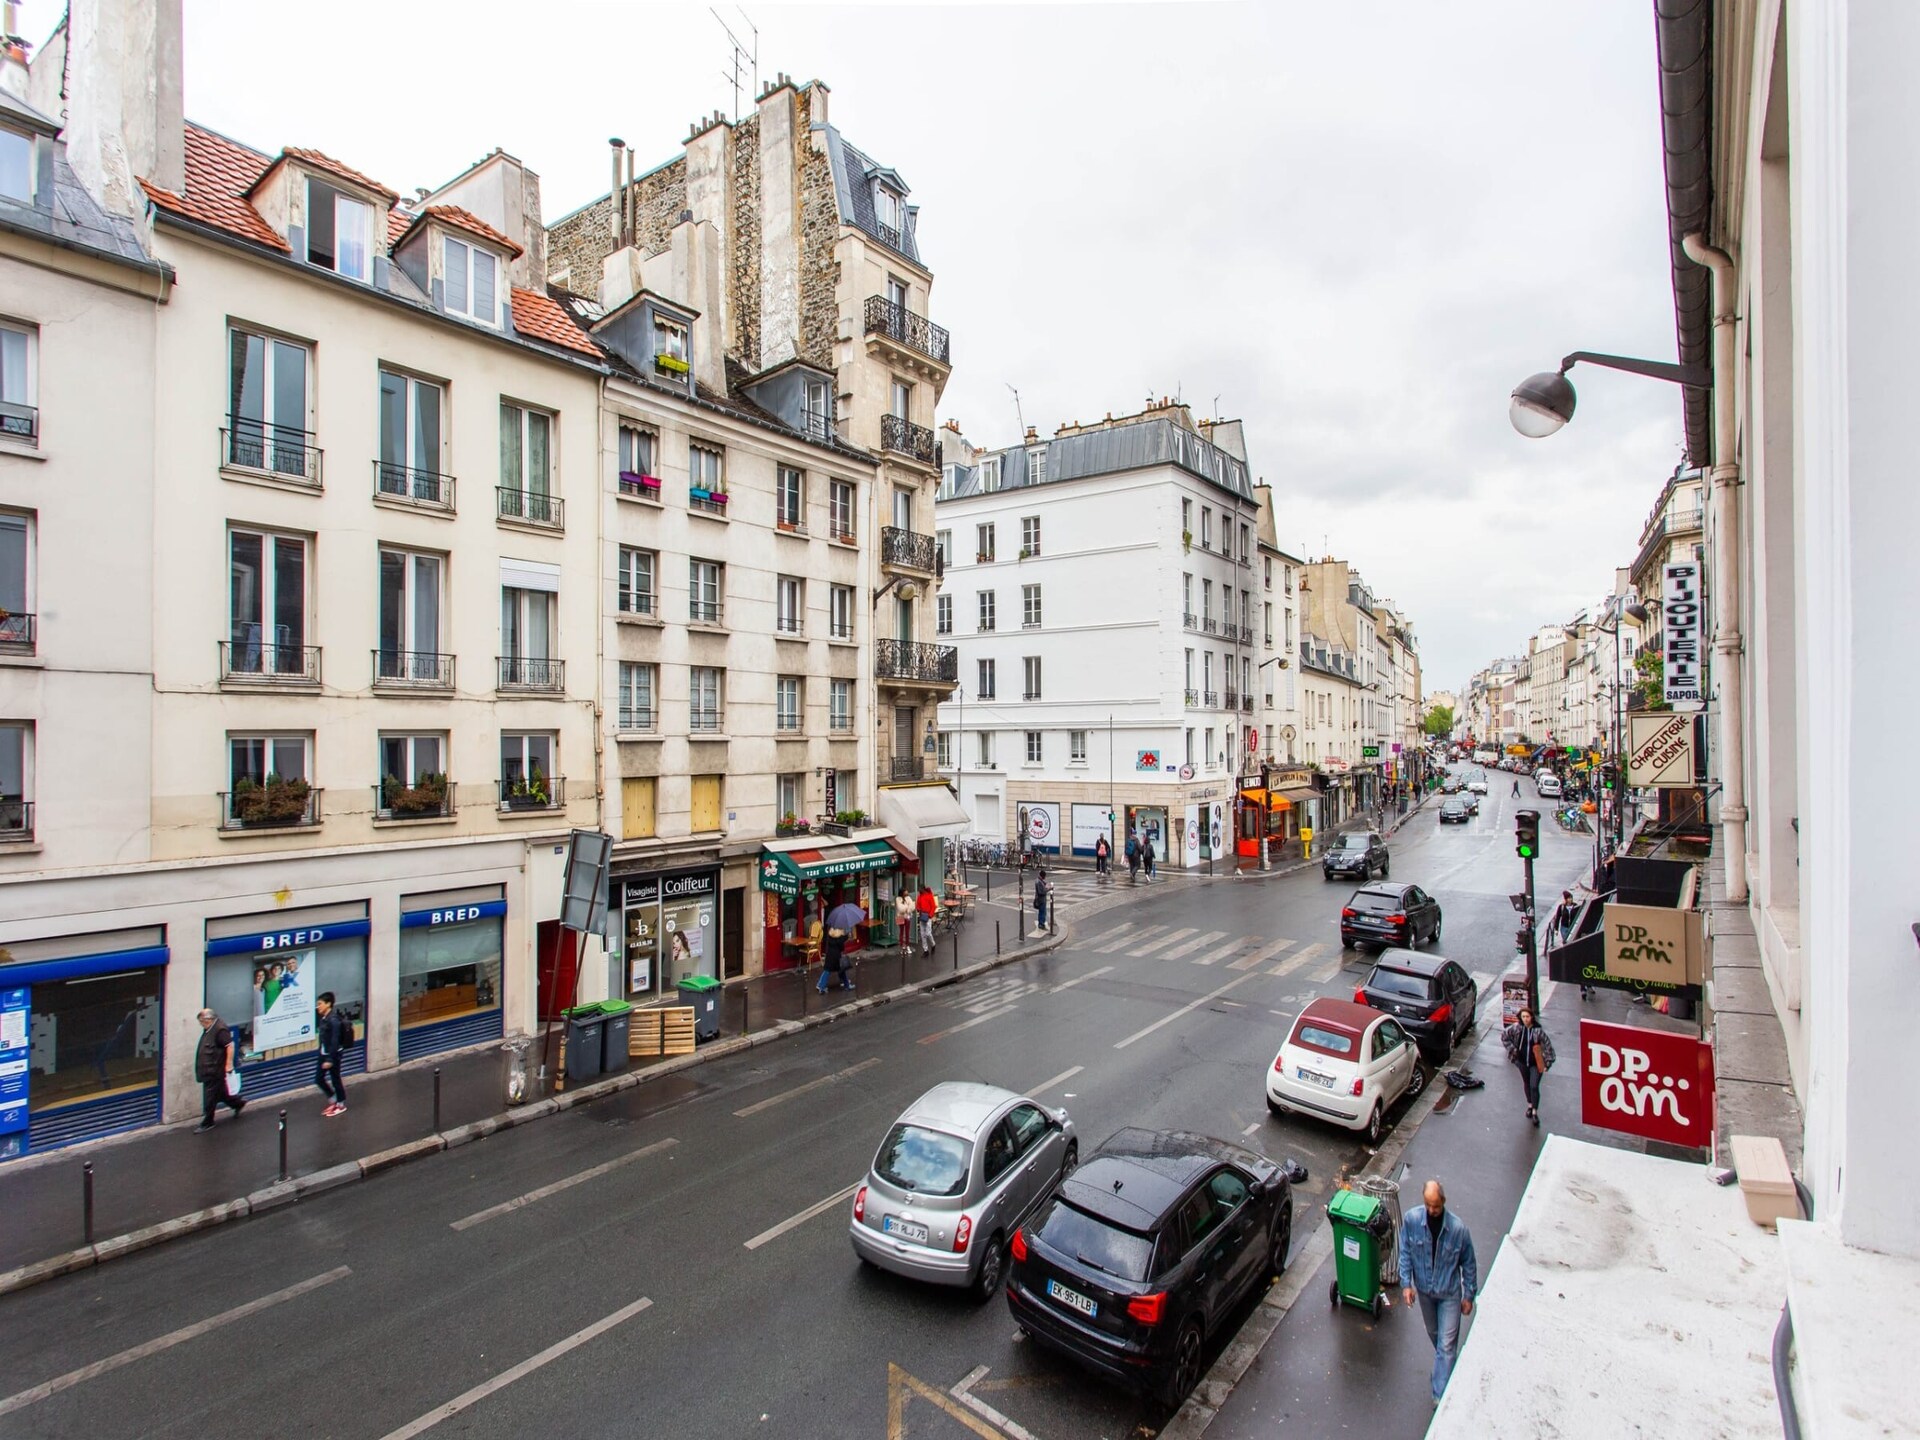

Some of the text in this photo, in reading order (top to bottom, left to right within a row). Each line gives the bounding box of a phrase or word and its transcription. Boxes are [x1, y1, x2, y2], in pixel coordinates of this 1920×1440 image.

[1666, 567, 1698, 687] BIJOUTERIE
[1666, 690, 1699, 700] SAPOR
[1630, 715, 1690, 770] CHARCUTERIE
[1652, 737, 1688, 769] CUISINE
[826, 769, 835, 816] PIZZA
[825, 864, 844, 874] CHEZ
[845, 861, 865, 870] TONY
[627, 886, 657, 897] Visagiste
[665, 877, 710, 893] Coiffeur
[763, 880, 779, 890] CHEZ
[780, 884, 797, 895] TONY
[431, 907, 480, 924] BRED
[262, 929, 324, 949] BRED
[1600, 1076, 1690, 1126] am
